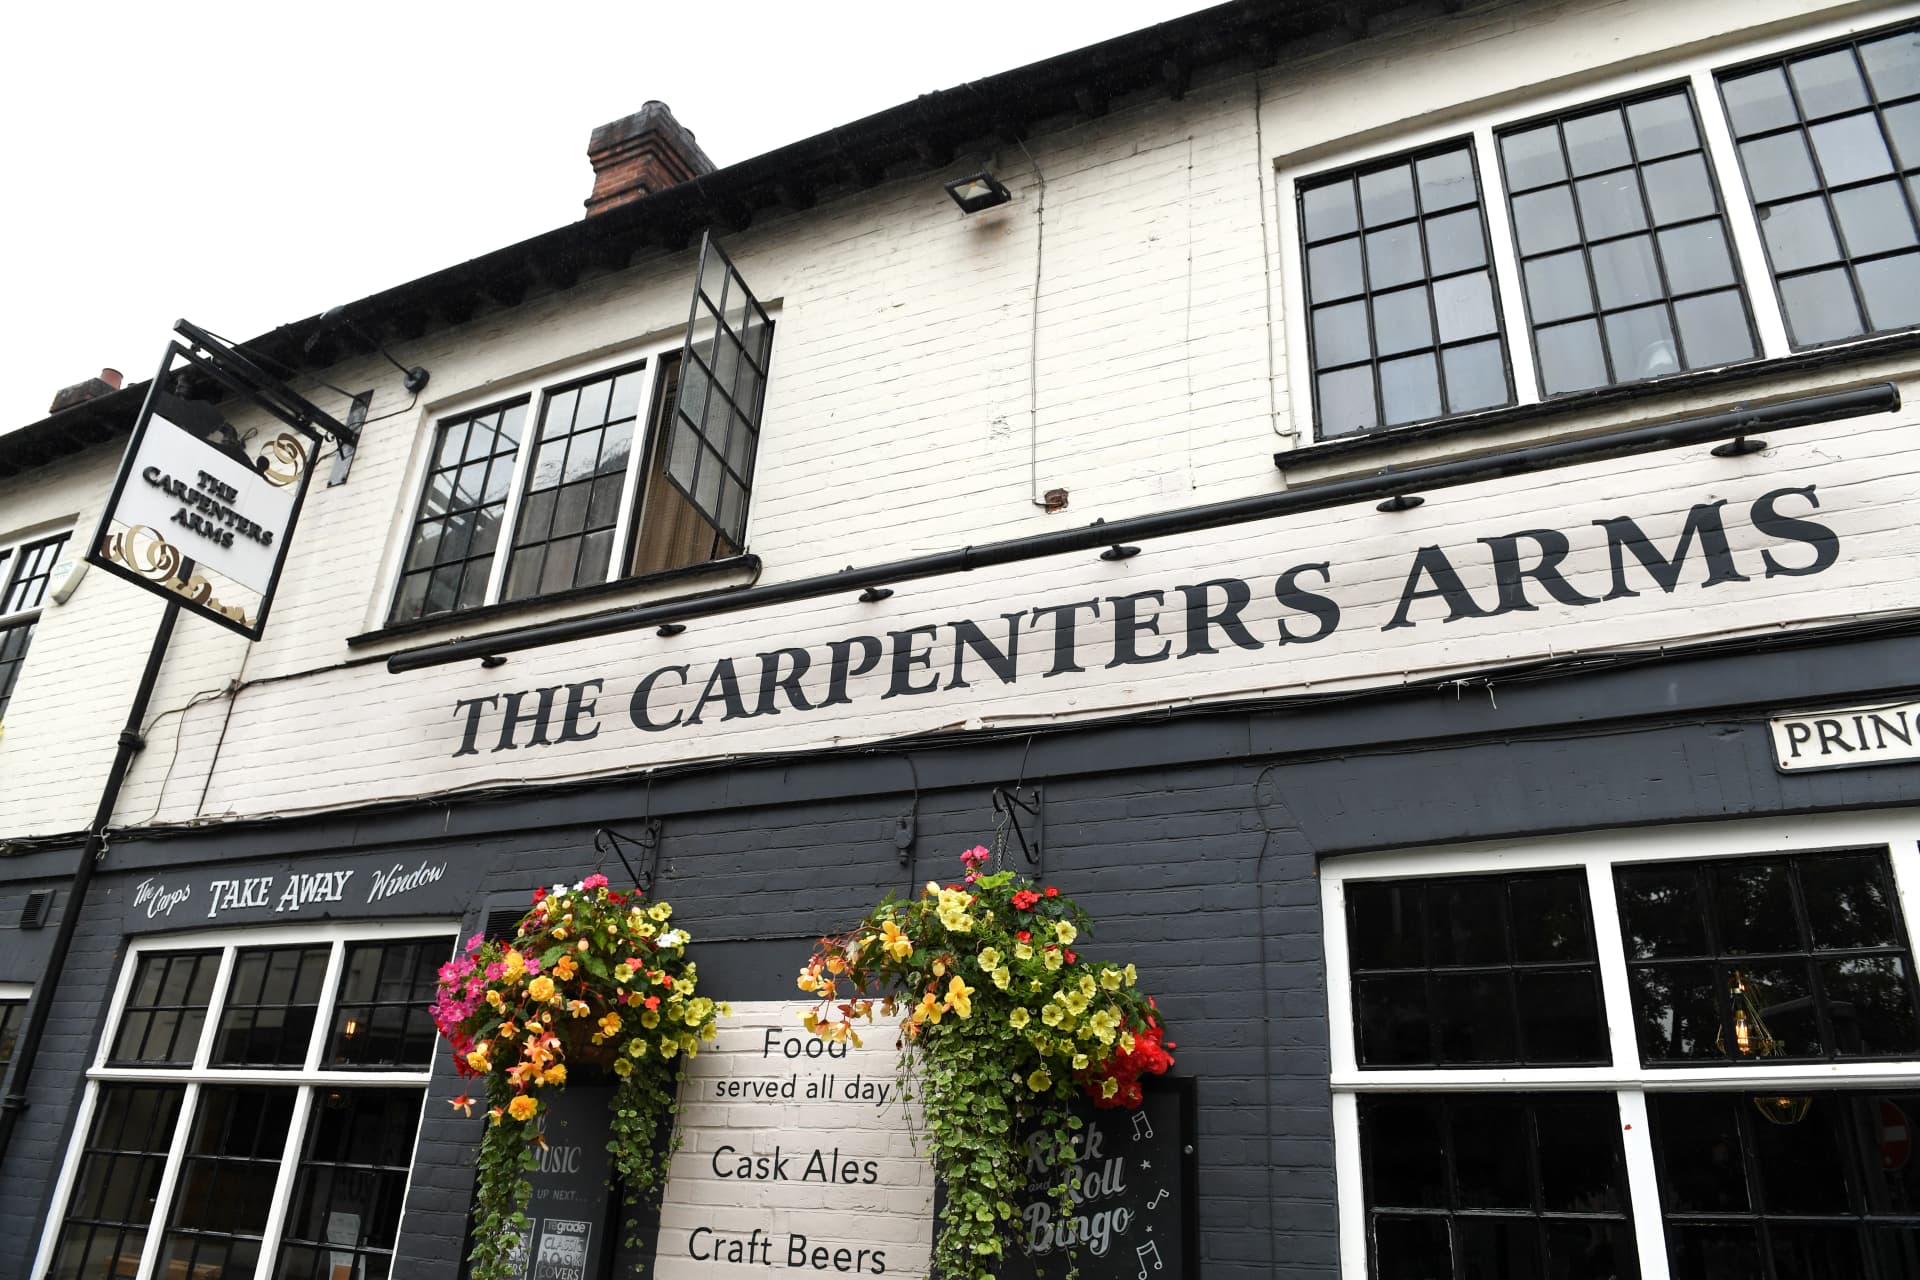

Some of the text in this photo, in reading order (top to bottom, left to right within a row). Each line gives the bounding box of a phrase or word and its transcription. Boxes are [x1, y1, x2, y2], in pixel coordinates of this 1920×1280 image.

[143, 466, 273, 547] CARPENTERS
[197, 470, 238, 505] THE
[170, 507, 234, 549] ARMS
[452, 484, 1841, 758] THE CARPENTERS ARMS
[1784, 711, 1920, 757] PRIN
[133, 877, 155, 907] The
[208, 876, 273, 918] TAKE
[276, 870, 353, 912] AWAY
[367, 860, 447, 903] Window
[763, 1028, 847, 1059] Food
[716, 1074, 890, 1107] served all day
[712, 1145, 879, 1184] Cask Ales
[1061, 1157, 1127, 1204] Roll
[537, 1188, 549, 1199] UP
[688, 1227, 886, 1275] Craft Beers
[1022, 1202, 1135, 1256] Bingo
